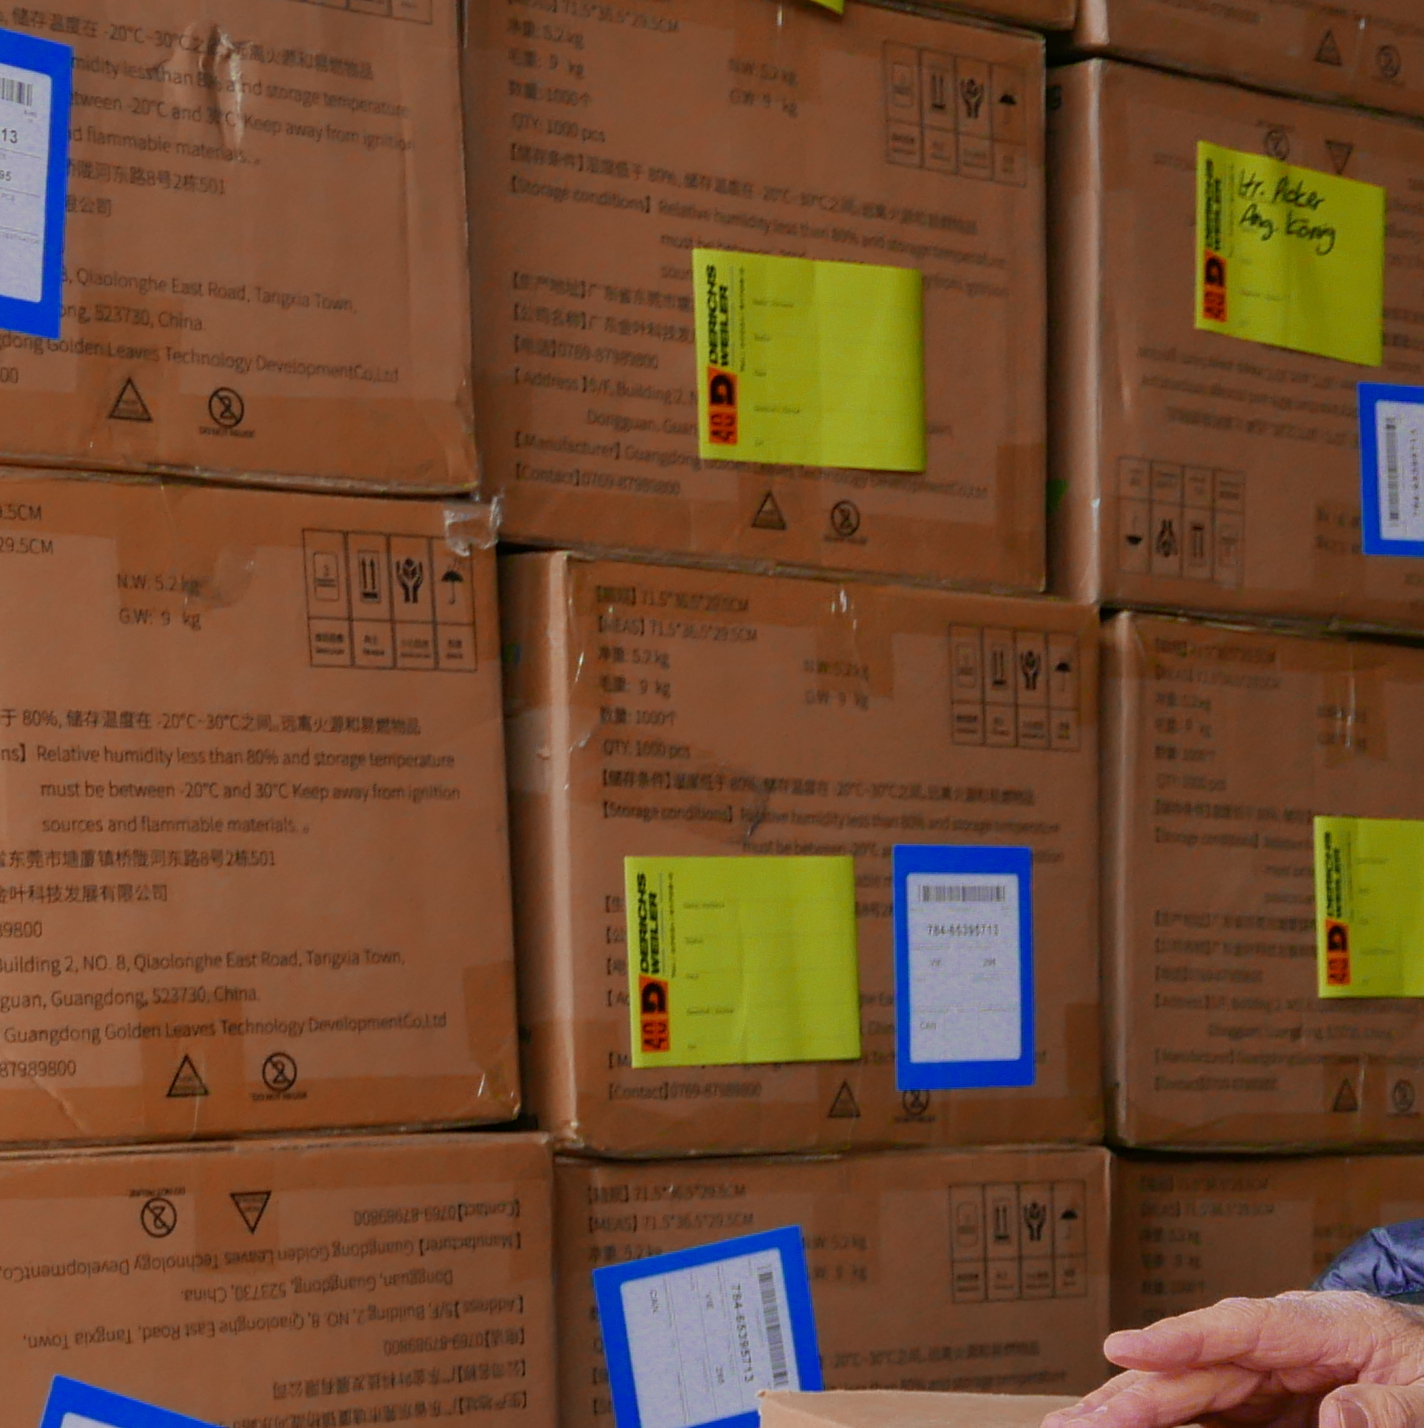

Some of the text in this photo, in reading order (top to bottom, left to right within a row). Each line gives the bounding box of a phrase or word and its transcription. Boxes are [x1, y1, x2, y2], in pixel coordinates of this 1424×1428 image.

[87, 125, 172, 153] flammable
[172, 106, 201, 122] and
[285, 122, 323, 142] away
[325, 124, 359, 142] from
[363, 132, 415, 154] ignition
[75, 267, 167, 295] Qiaolonghe
[172, 277, 203, 297] East
[208, 282, 250, 303] Road,
[105, 343, 160, 362] Leaves
[165, 346, 253, 374] Technology
[155, 574, 180, 593] 5.2
[160, 610, 170, 625] 9
[182, 608, 201, 631] kg
[37, 745, 455, 770] Relative humidity less than 80% and storage temperature
[40, 783, 80, 797] must
[85, 780, 105, 798] be
[108, 780, 175, 798] between
[223, 781, 251, 799] and
[292, 783, 329, 802] Keep
[332, 787, 369, 802] away
[372, 783, 404, 800] from
[408, 785, 460, 804] ignition
[42, 819, 103, 832] sources
[108, 816, 137, 832] and
[141, 815, 223, 832] flammable
[65, 955, 79, 973] 2,
[133, 953, 222, 973] Qiaolonghe
[226, 952, 257, 968] East
[261, 950, 302, 967] Road,
[306, 950, 360, 970] Tangxia
[364, 949, 404, 965] Town,
[51, 988, 149, 1011] Guangdong,
[4, 1019, 305, 1046] Guangdong Golden Leaves Technology
[134, 1238, 414, 1272] Guangdong Golden Leaves Technology
[296, 1274, 376, 1294] Guangdong,
[379, 1268, 453, 1287] Dongguan,
[231, 1282, 287, 1302] 523730,
[219, 1312, 304, 1335] Qiaolonghe
[367, 1304, 425, 1322] Building
[75, 1326, 133, 1345] Tangxia
[138, 1325, 180, 1343] Road,
[184, 1321, 216, 1338] East
[23, 1334, 69, 1350] Town,
